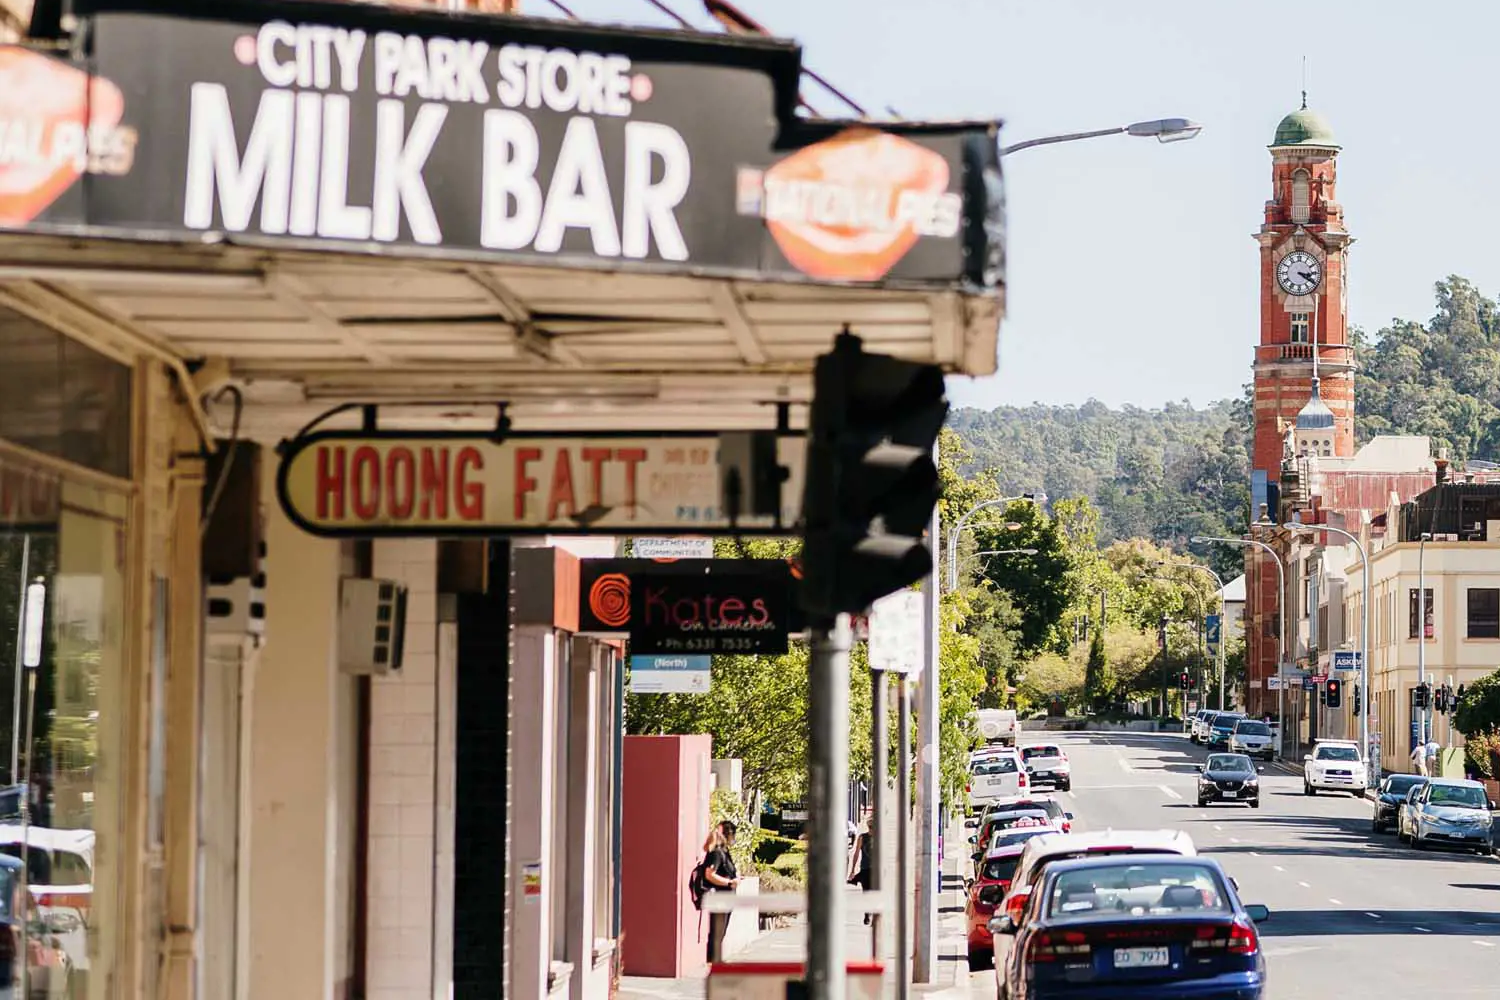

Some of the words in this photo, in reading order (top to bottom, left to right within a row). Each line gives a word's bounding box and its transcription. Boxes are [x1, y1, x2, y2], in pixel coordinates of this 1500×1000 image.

[257, 20, 366, 92] CITY
[375, 31, 490, 104] PARK
[498, 43, 632, 117] STORE
[183, 81, 449, 245] MILK
[480, 108, 691, 262] BAR
[315, 445, 486, 521] HOONG
[513, 446, 647, 521] FATT
[644, 586, 770, 625] Kates
[653, 657, 688, 670] (North)
